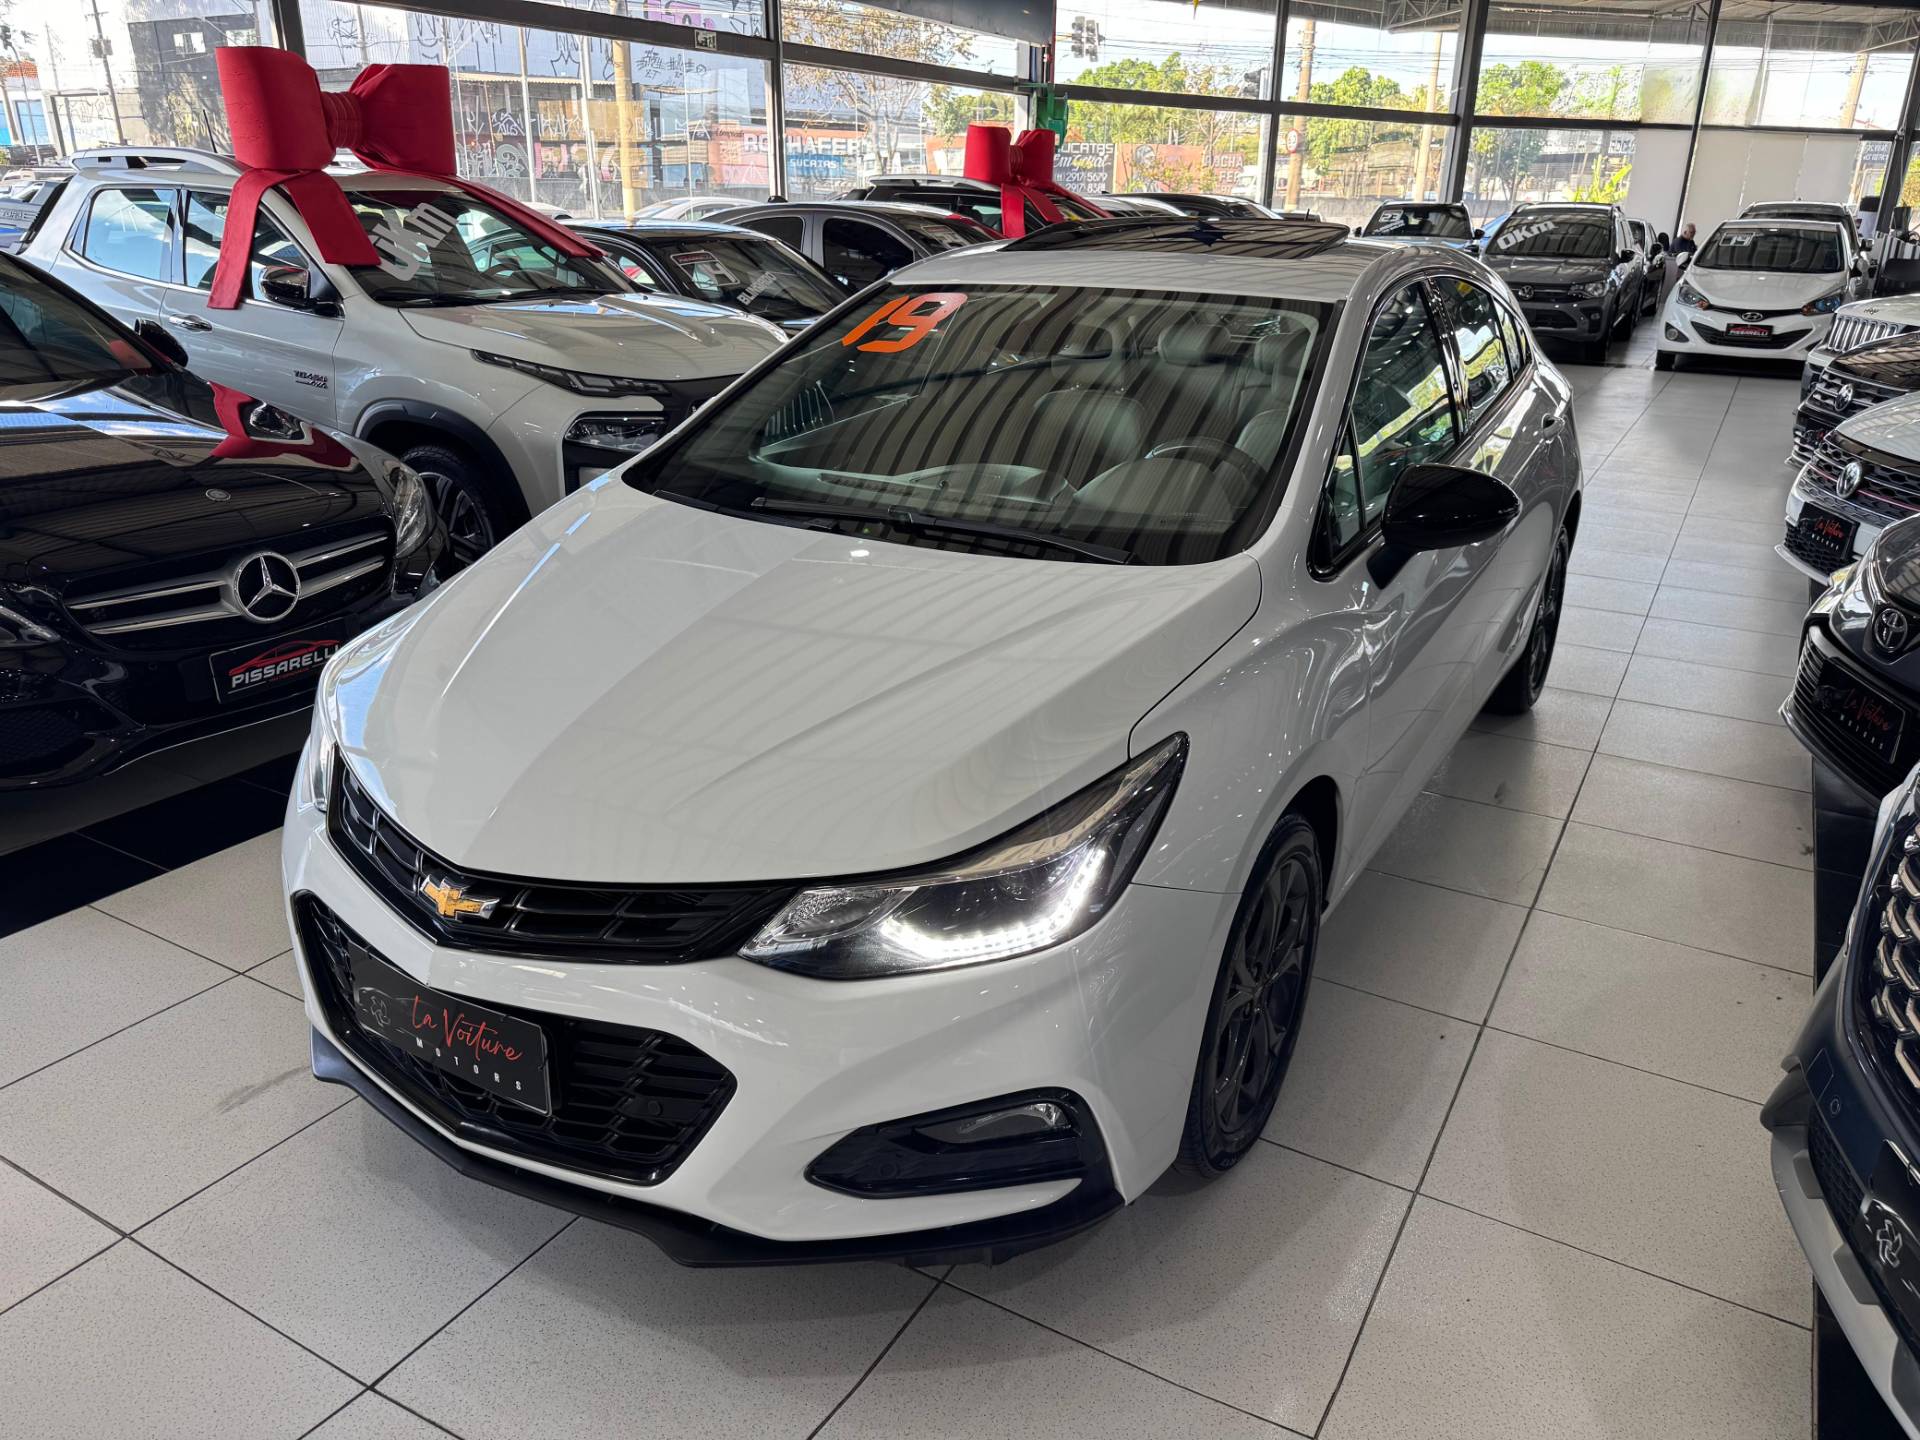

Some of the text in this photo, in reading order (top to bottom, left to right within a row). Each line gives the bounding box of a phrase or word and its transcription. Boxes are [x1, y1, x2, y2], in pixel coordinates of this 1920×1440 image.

[744, 133, 861, 156] ROHAFER
[1058, 143, 1114, 155] UCATAS
[842, 292, 968, 353] 19
[231, 643, 341, 688] PISSARELLI
[411, 994, 523, 1062] La Voiture
[415, 1036, 522, 1091] MOTORS
